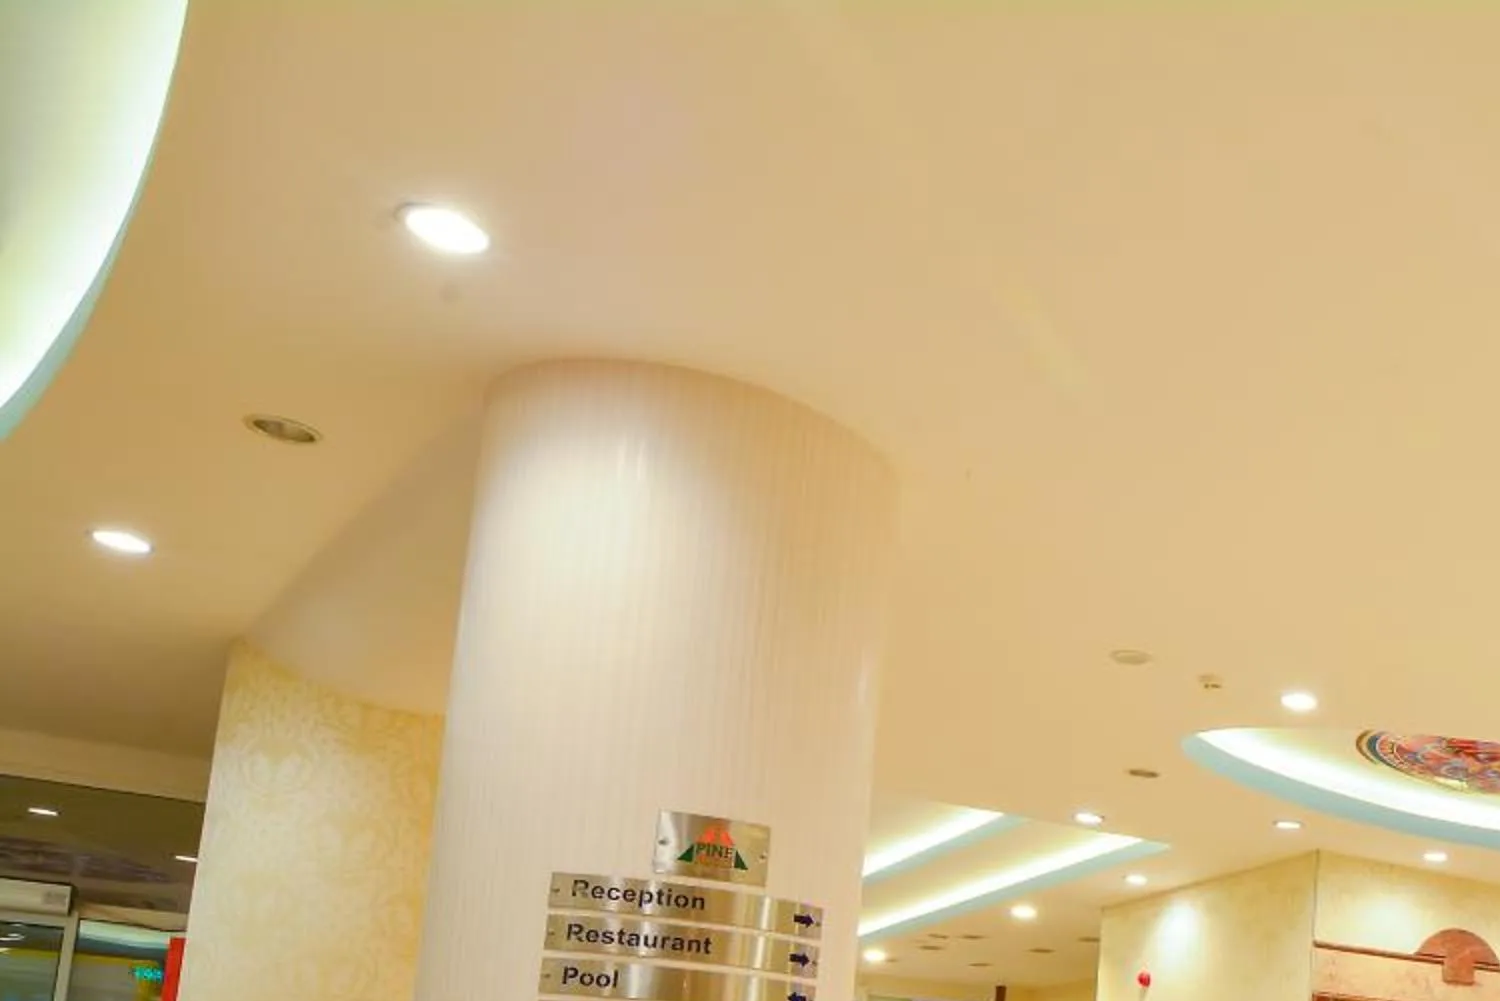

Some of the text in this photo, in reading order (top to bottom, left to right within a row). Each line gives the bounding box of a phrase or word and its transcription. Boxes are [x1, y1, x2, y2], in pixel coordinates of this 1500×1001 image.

[695, 842, 734, 859] PINE
[572, 879, 706, 911] Reception
[566, 923, 712, 955] Restaurant
[562, 966, 619, 990] Pool
